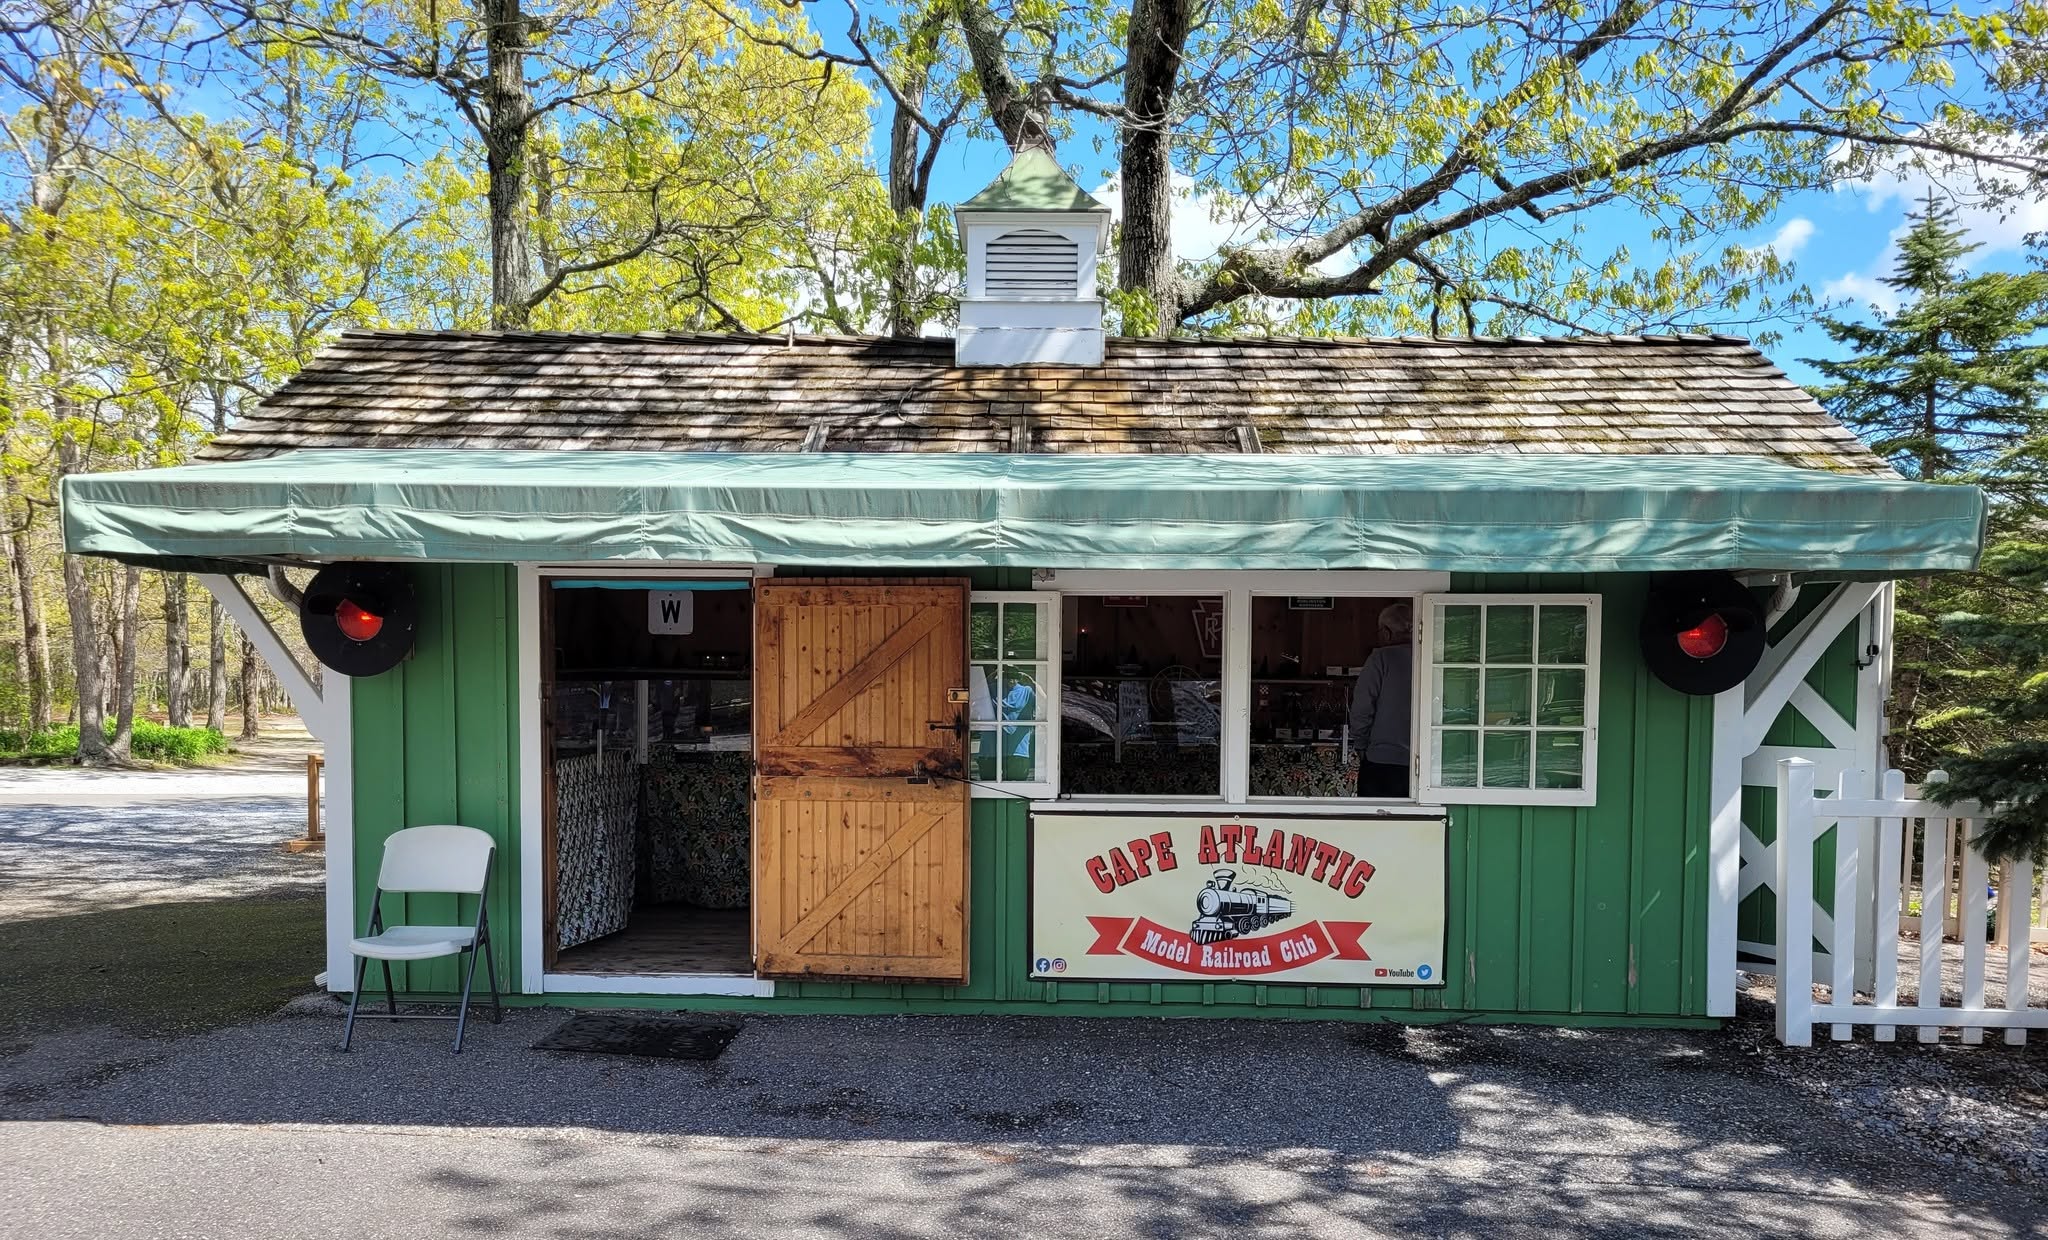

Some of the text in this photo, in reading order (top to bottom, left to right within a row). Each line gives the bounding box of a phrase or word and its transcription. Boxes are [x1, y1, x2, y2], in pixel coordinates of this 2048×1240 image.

[661, 600, 681, 623] W
[1085, 825, 1377, 899] CAPE ATLANTIC
[1140, 929, 1317, 968] Model Railroad Club
[1389, 969, 1414, 977] YouTube
